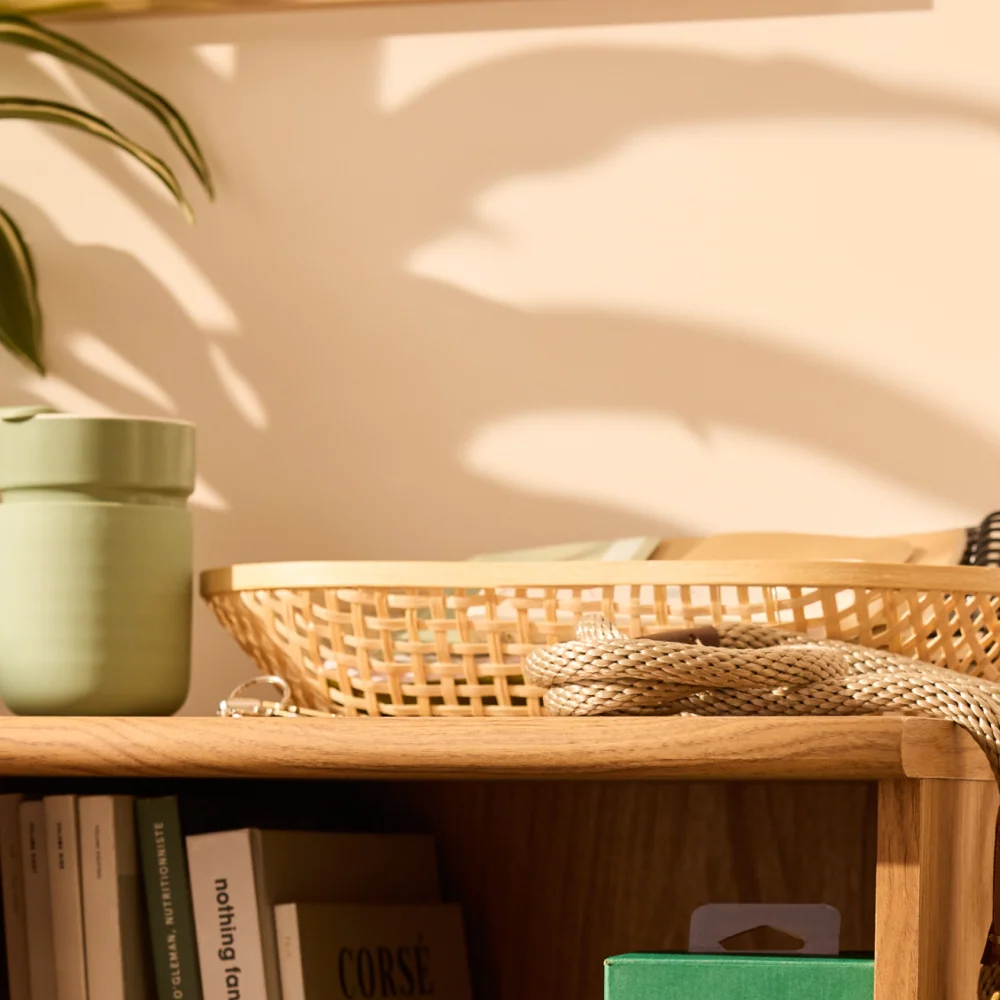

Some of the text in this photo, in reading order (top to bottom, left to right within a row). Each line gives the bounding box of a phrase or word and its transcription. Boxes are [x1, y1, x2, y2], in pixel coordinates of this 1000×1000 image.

[153, 822, 174, 926] NUTRITIONNISTE
[214, 878, 237, 961] nothing
[337, 931, 435, 1000] CORSÉ
